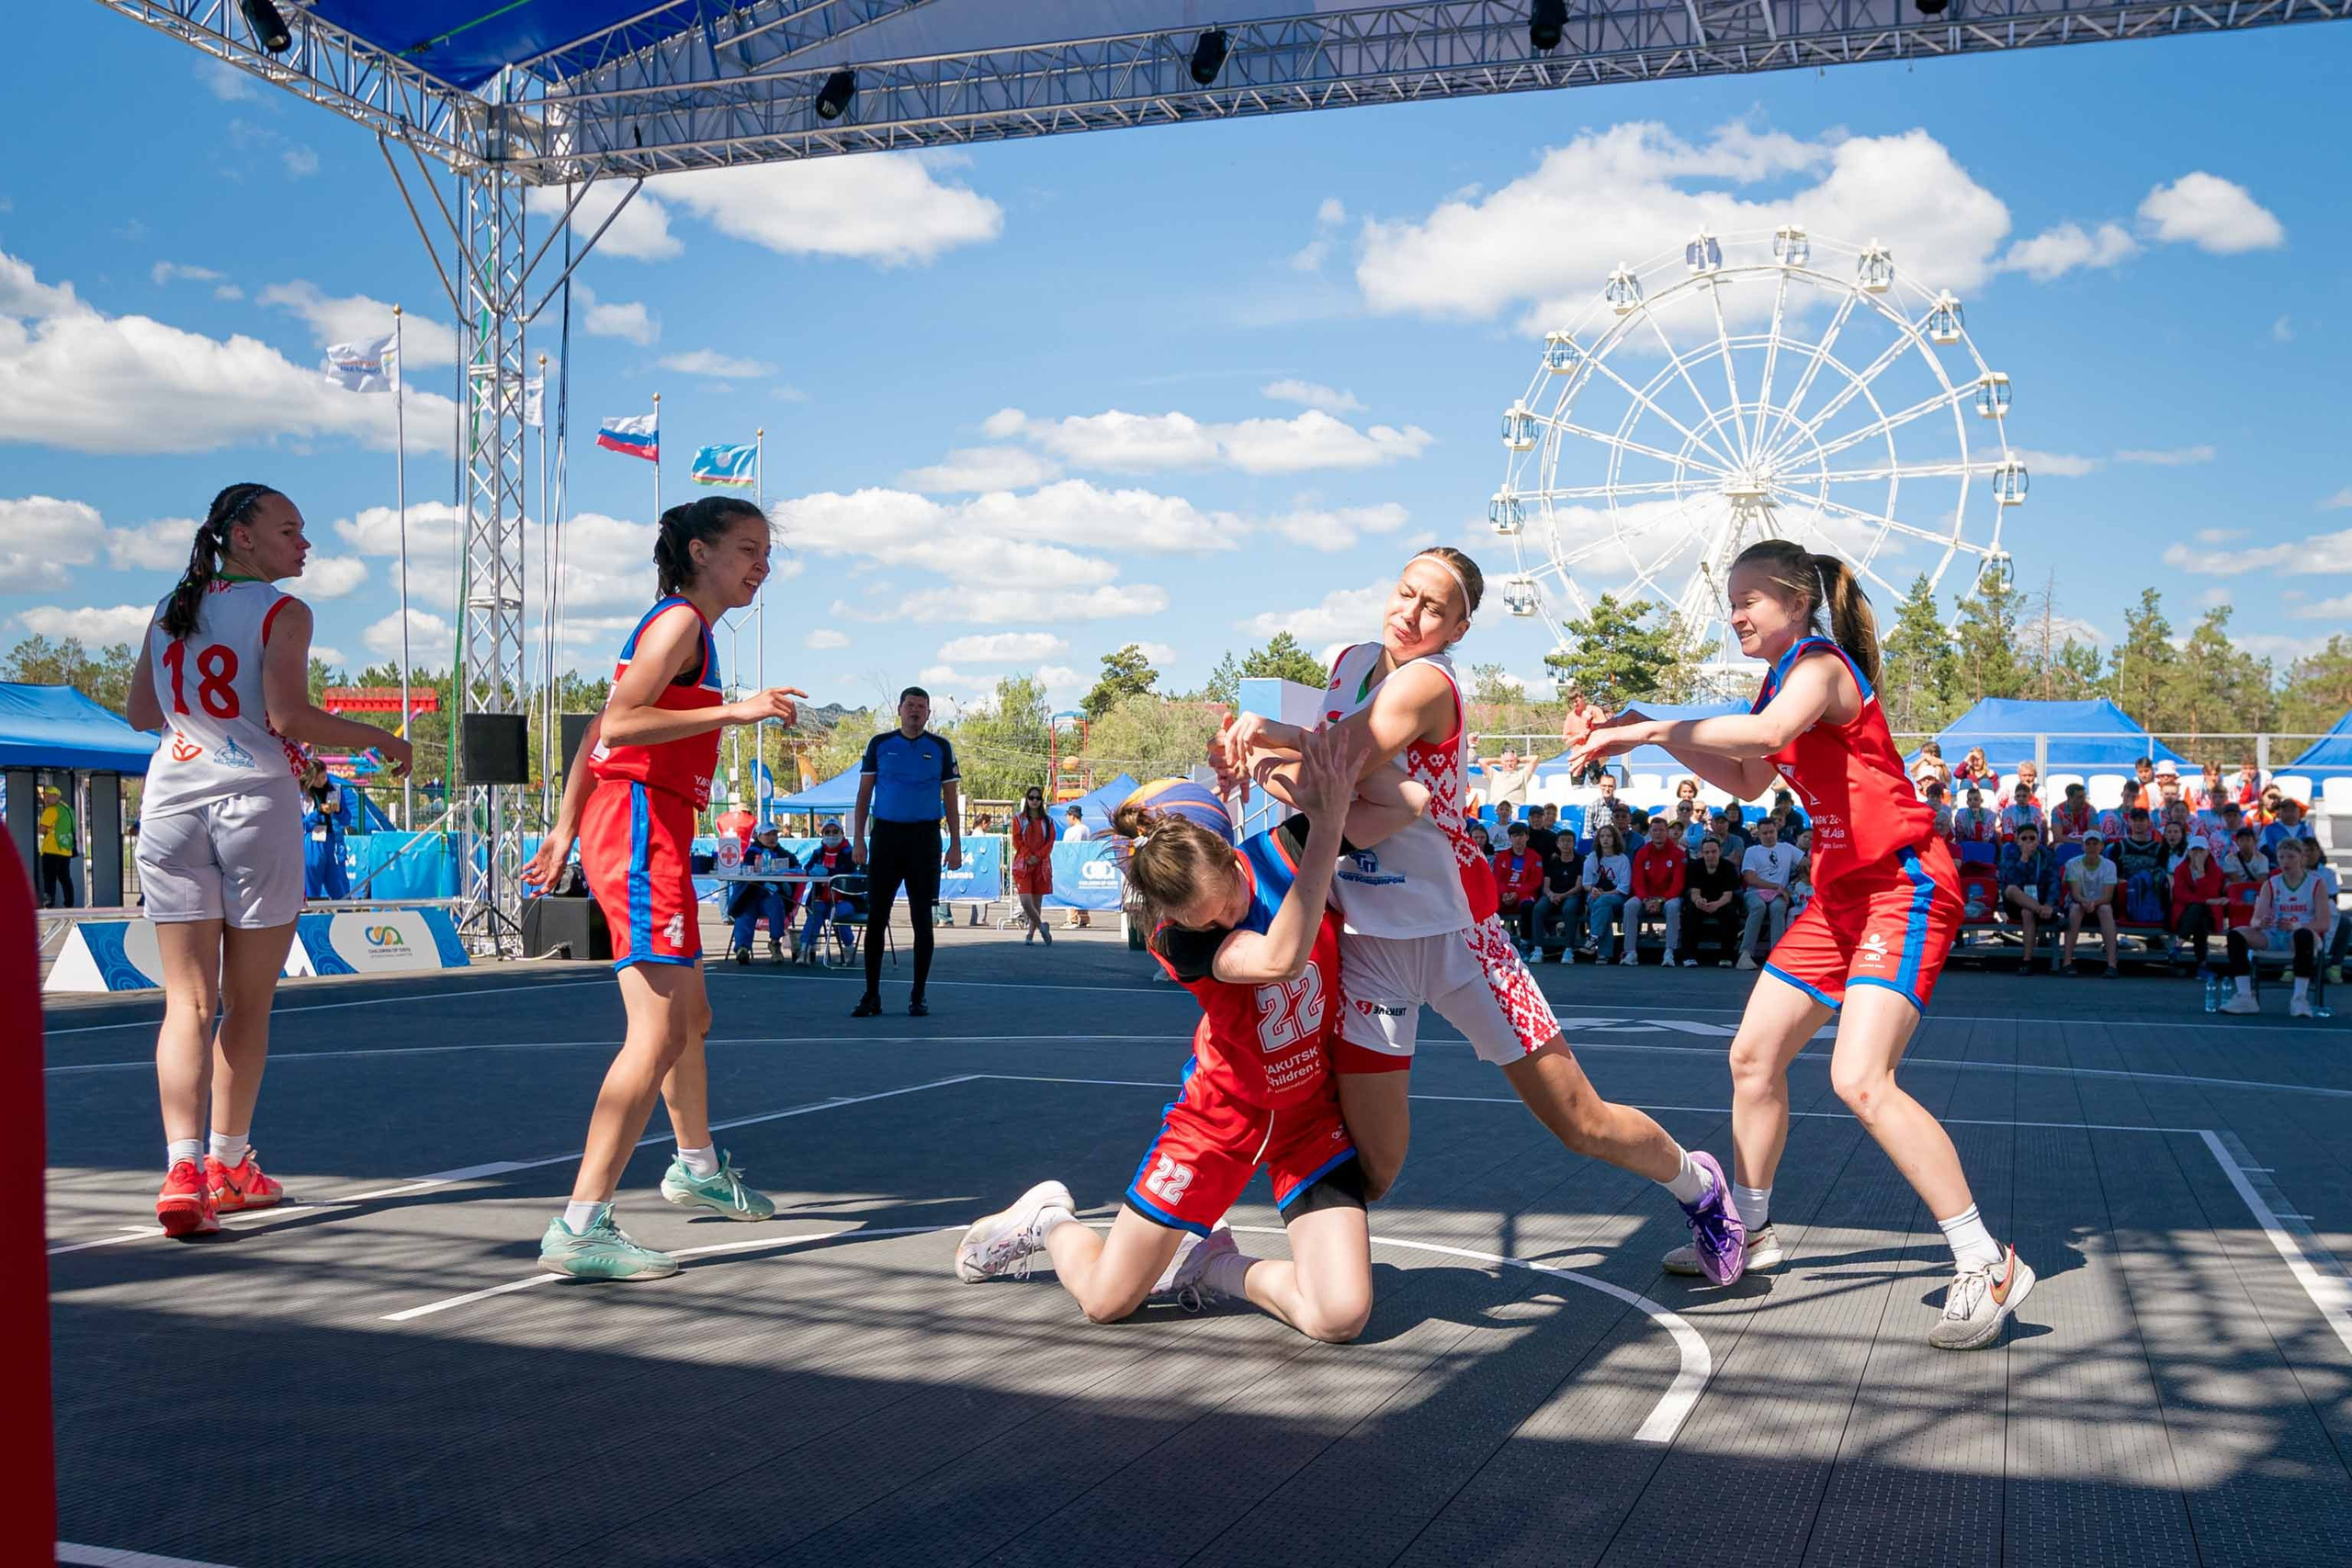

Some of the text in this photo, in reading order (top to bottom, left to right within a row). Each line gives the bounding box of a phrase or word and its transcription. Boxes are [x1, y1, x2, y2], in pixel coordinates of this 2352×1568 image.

[163, 638, 240, 719] 18
[663, 912, 684, 948] 4
[1254, 960, 1326, 1054] 22
[1263, 1045, 1318, 1075] AKUTSK
[1146, 1152, 1193, 1206] 22
